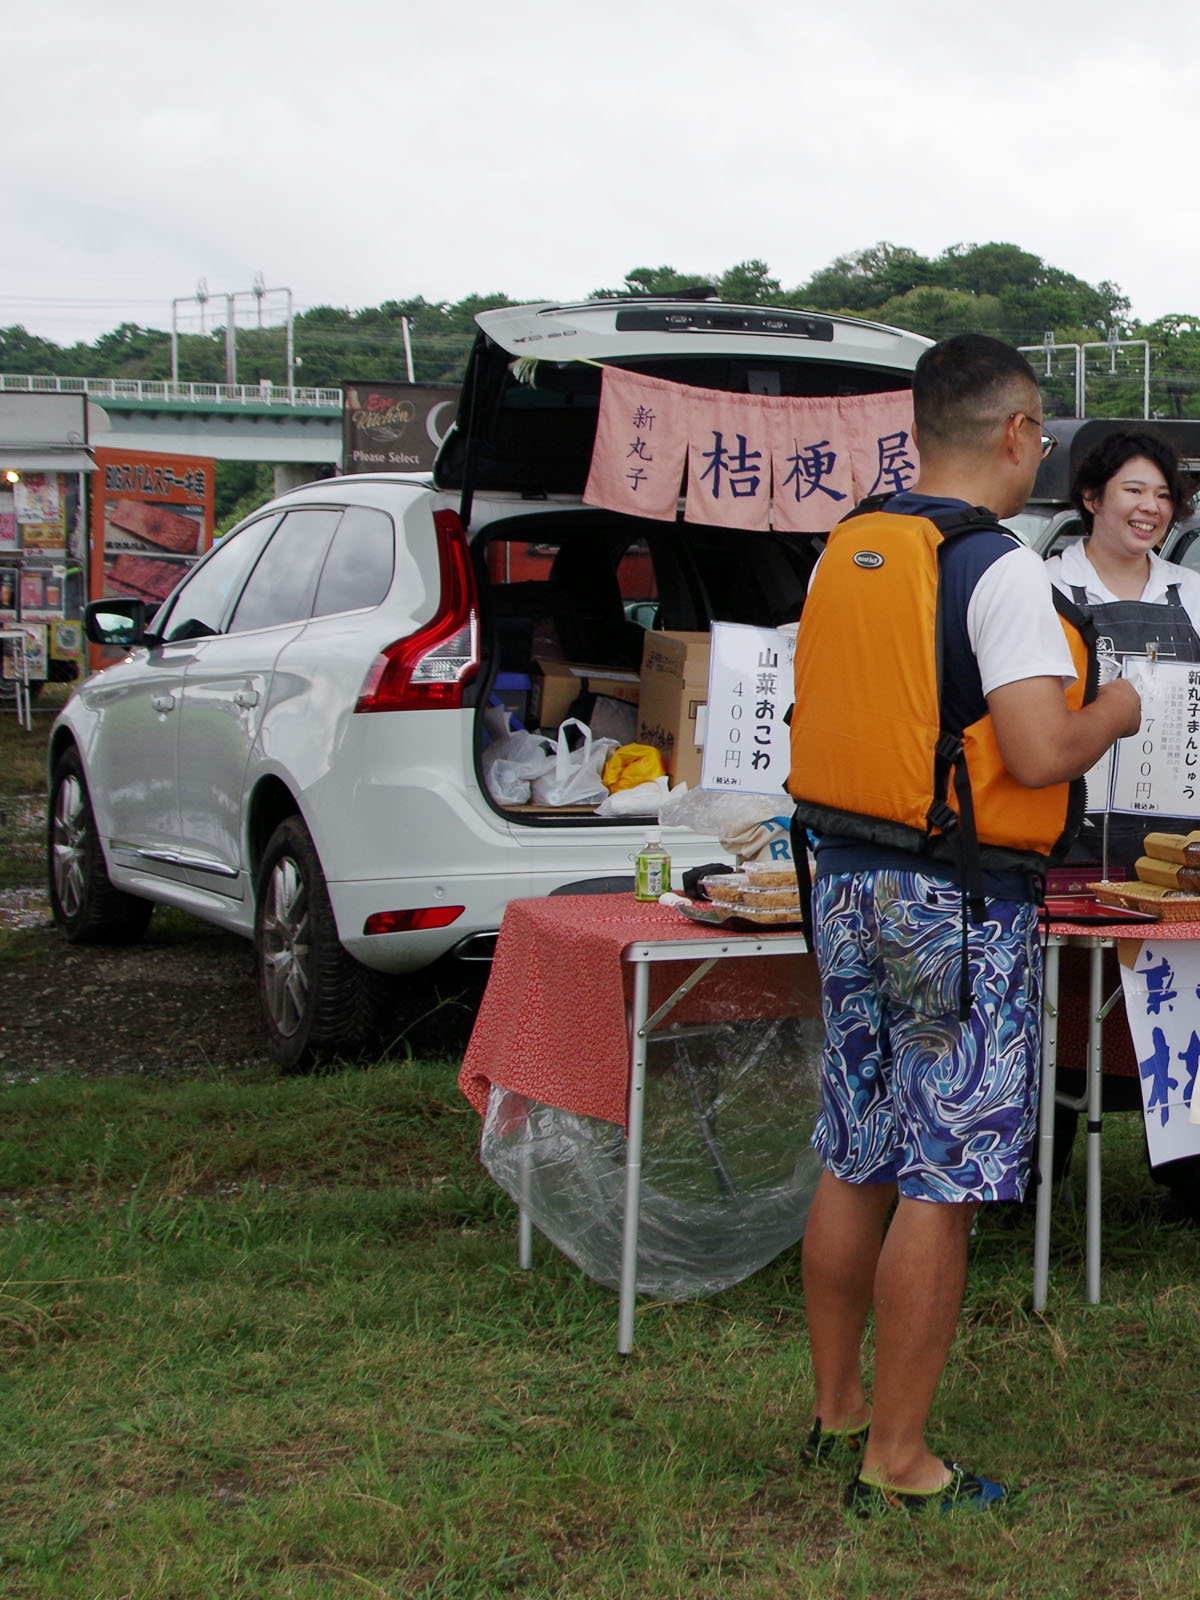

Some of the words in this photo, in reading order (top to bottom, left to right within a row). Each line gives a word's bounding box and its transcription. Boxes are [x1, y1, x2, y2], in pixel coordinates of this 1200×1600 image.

[353, 450, 386, 463] Please
[388, 451, 420, 464] Select
[625, 404, 656, 493] 新丸子
[699, 429, 918, 503] 桔梗屋
[724, 681, 744, 769] 400円
[751, 648, 779, 770] 山菜おこわ
[1182, 670, 1200, 800] 新丸子まんじゅう
[1135, 718, 1155, 800] 700円
